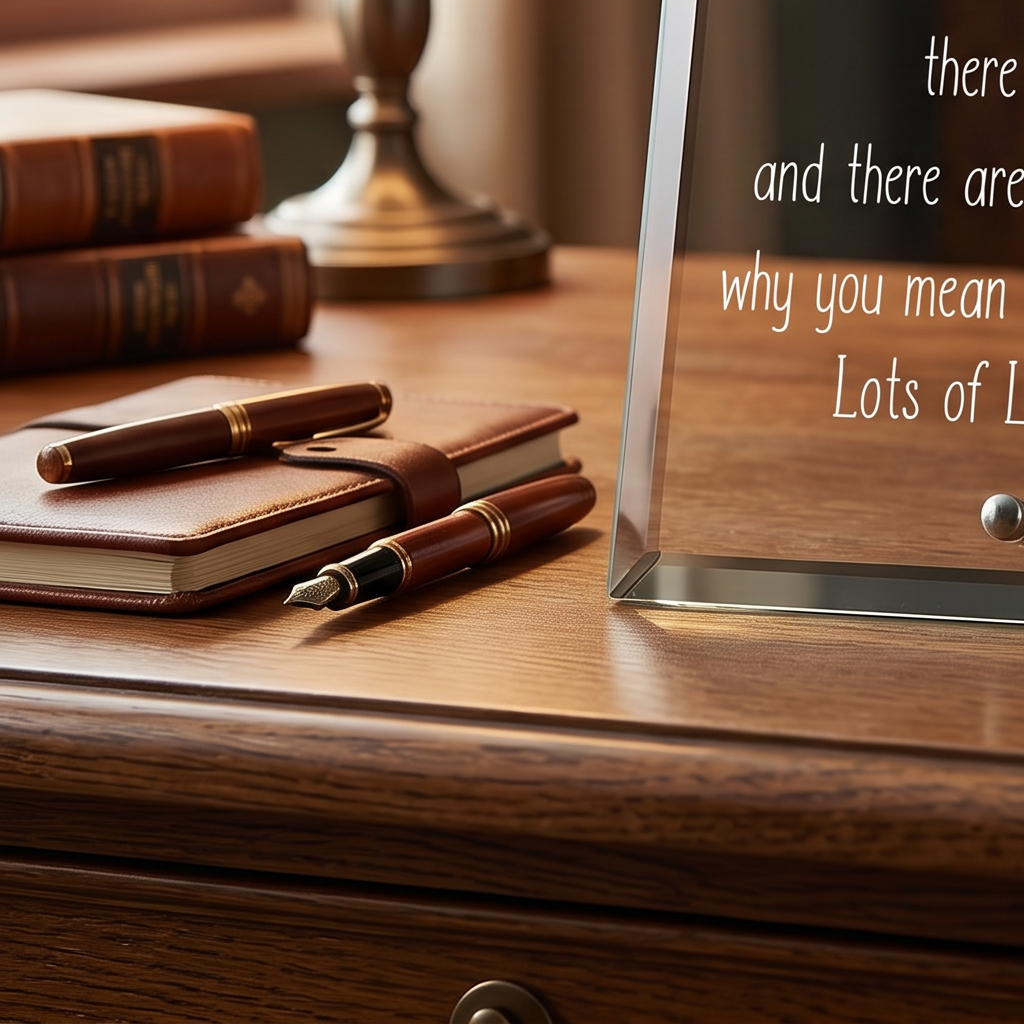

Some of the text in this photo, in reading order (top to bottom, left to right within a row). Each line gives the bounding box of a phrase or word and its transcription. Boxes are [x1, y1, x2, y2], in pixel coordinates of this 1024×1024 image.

[924, 35, 1018, 98] there
[753, 142, 825, 204] and
[847, 142, 941, 206] there
[721, 249, 794, 333] why
[814, 272, 883, 334] you
[904, 274, 1006, 320] mean
[832, 354, 920, 420] Lots
[943, 359, 990, 423] of
